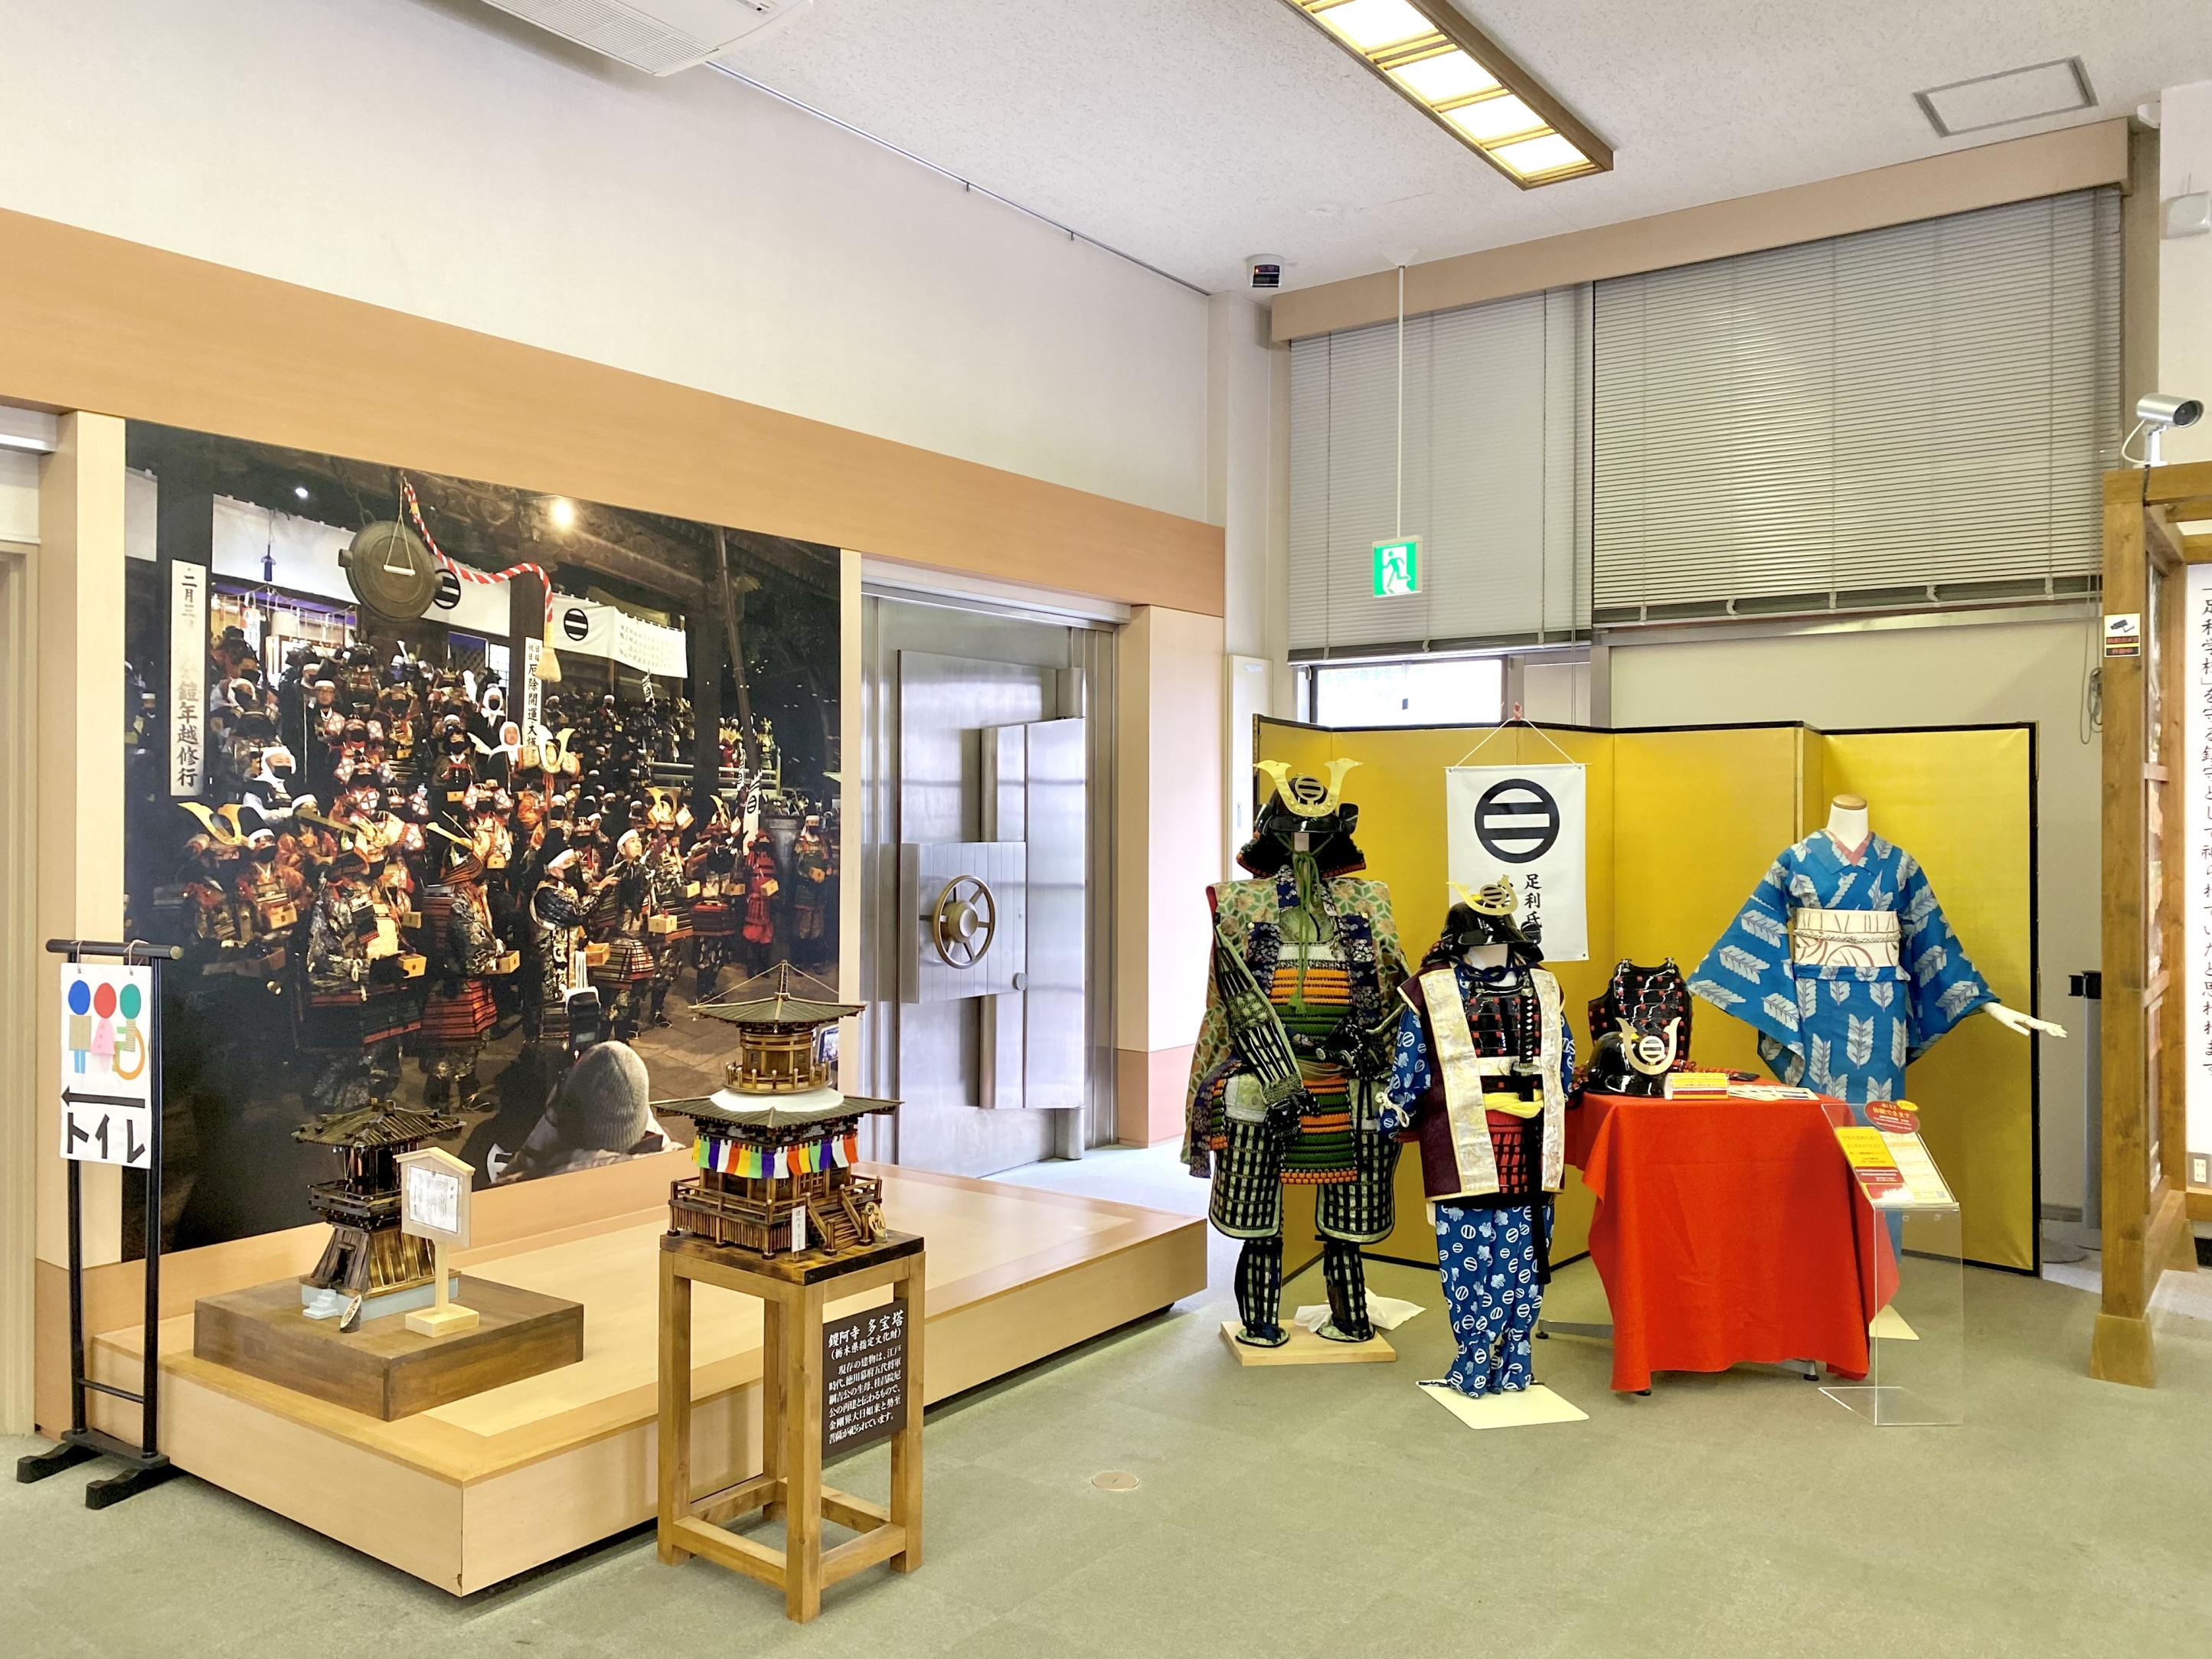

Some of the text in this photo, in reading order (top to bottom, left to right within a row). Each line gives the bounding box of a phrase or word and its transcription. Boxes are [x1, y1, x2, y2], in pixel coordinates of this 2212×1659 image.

[1524, 874, 1543, 927] 足利氏
[67, 1112, 145, 1164] トイレ
[867, 1309, 903, 1337] 多宝塔
